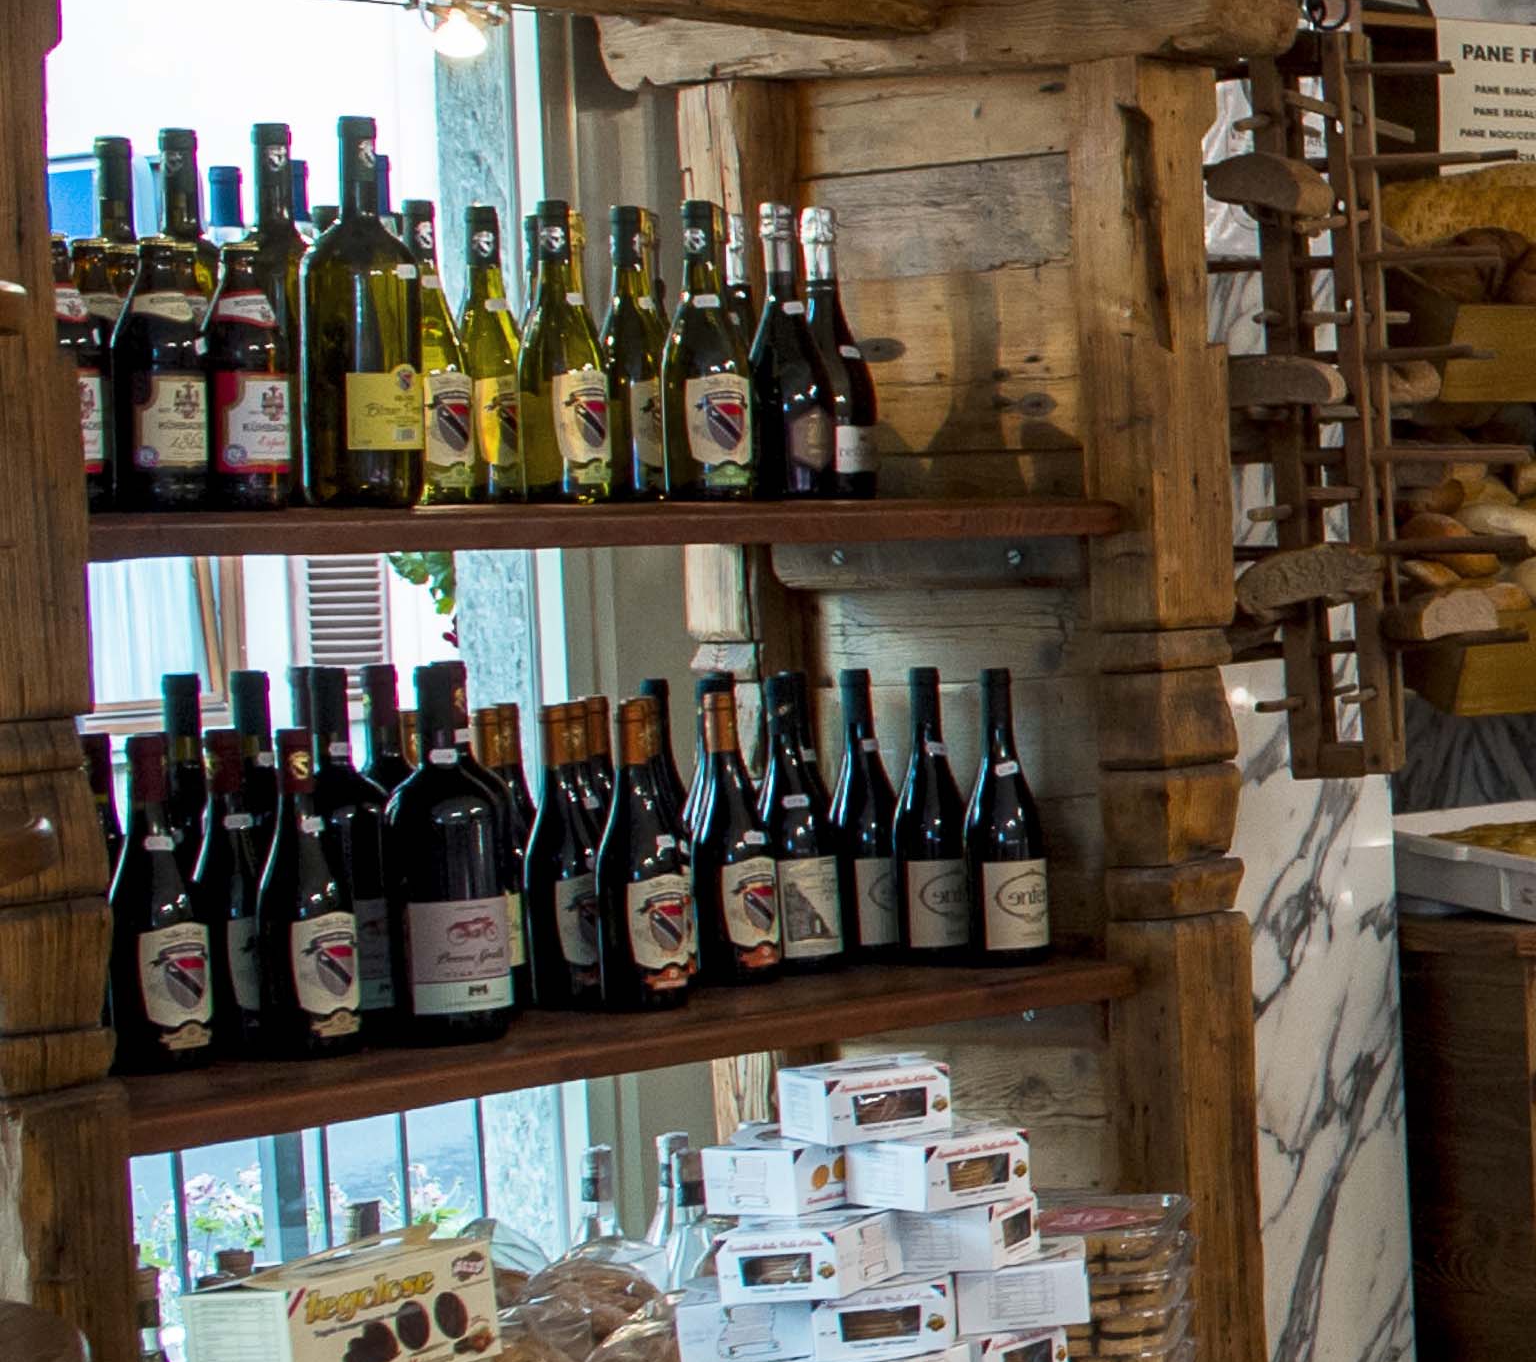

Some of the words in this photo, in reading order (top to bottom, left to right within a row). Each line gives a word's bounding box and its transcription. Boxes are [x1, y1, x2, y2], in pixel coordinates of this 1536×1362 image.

[1461, 43, 1515, 63] PANE
[1474, 84, 1500, 96] PANE
[1473, 107, 1499, 117] PANE
[1459, 128, 1485, 138] PANE
[305, 1271, 435, 1325] tegolose
